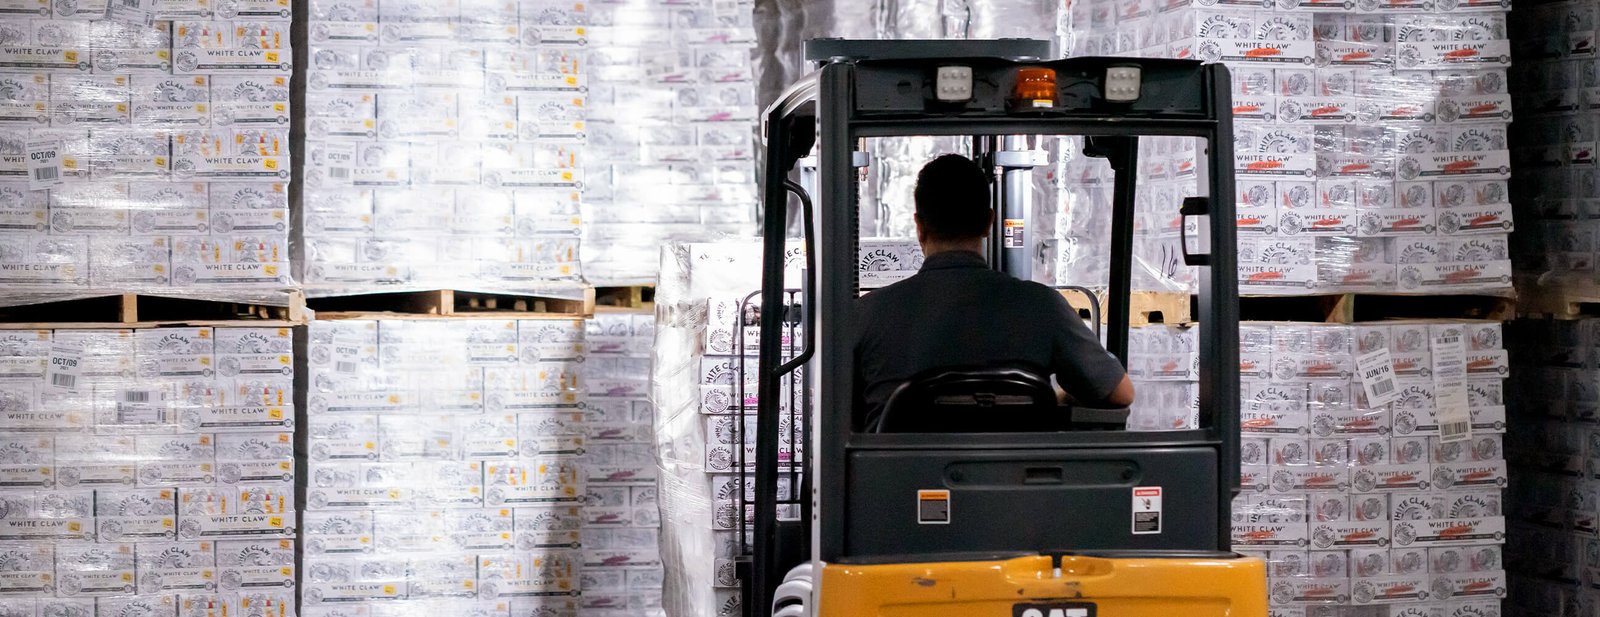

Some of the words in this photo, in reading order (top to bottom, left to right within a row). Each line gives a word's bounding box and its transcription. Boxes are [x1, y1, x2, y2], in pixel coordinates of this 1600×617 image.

[1214, 14, 1238, 29] CLAW
[1274, 17, 1296, 31] CLAW
[245, 80, 266, 92] CLAW
[1274, 130, 1296, 144] CLAW
[1413, 131, 1435, 144] CLAW
[1468, 129, 1491, 142] CLAW
[31, 150, 56, 160] OCT/09
[245, 188, 264, 198] CLAW
[1276, 242, 1298, 256] CLAW
[1414, 242, 1438, 256] CLAW
[1470, 240, 1492, 253] CLAW
[860, 252, 874, 271] HITE
[875, 249, 900, 263] CLAW
[170, 334, 190, 344] CLAW
[250, 332, 269, 344] CLAW
[52, 357, 78, 367] OCT/09
[706, 365, 720, 383] HITE
[1366, 364, 1389, 379] JUN/16
[1268, 388, 1289, 400] CLAW
[1410, 386, 1432, 399] CLAW
[250, 438, 270, 450] CLAW
[718, 481, 733, 500] HITE
[1409, 497, 1432, 510] CLAW
[1464, 495, 1486, 508] CLAW
[171, 547, 190, 558] CLAW
[250, 545, 270, 556] CLAW
[722, 596, 738, 615] HITE
